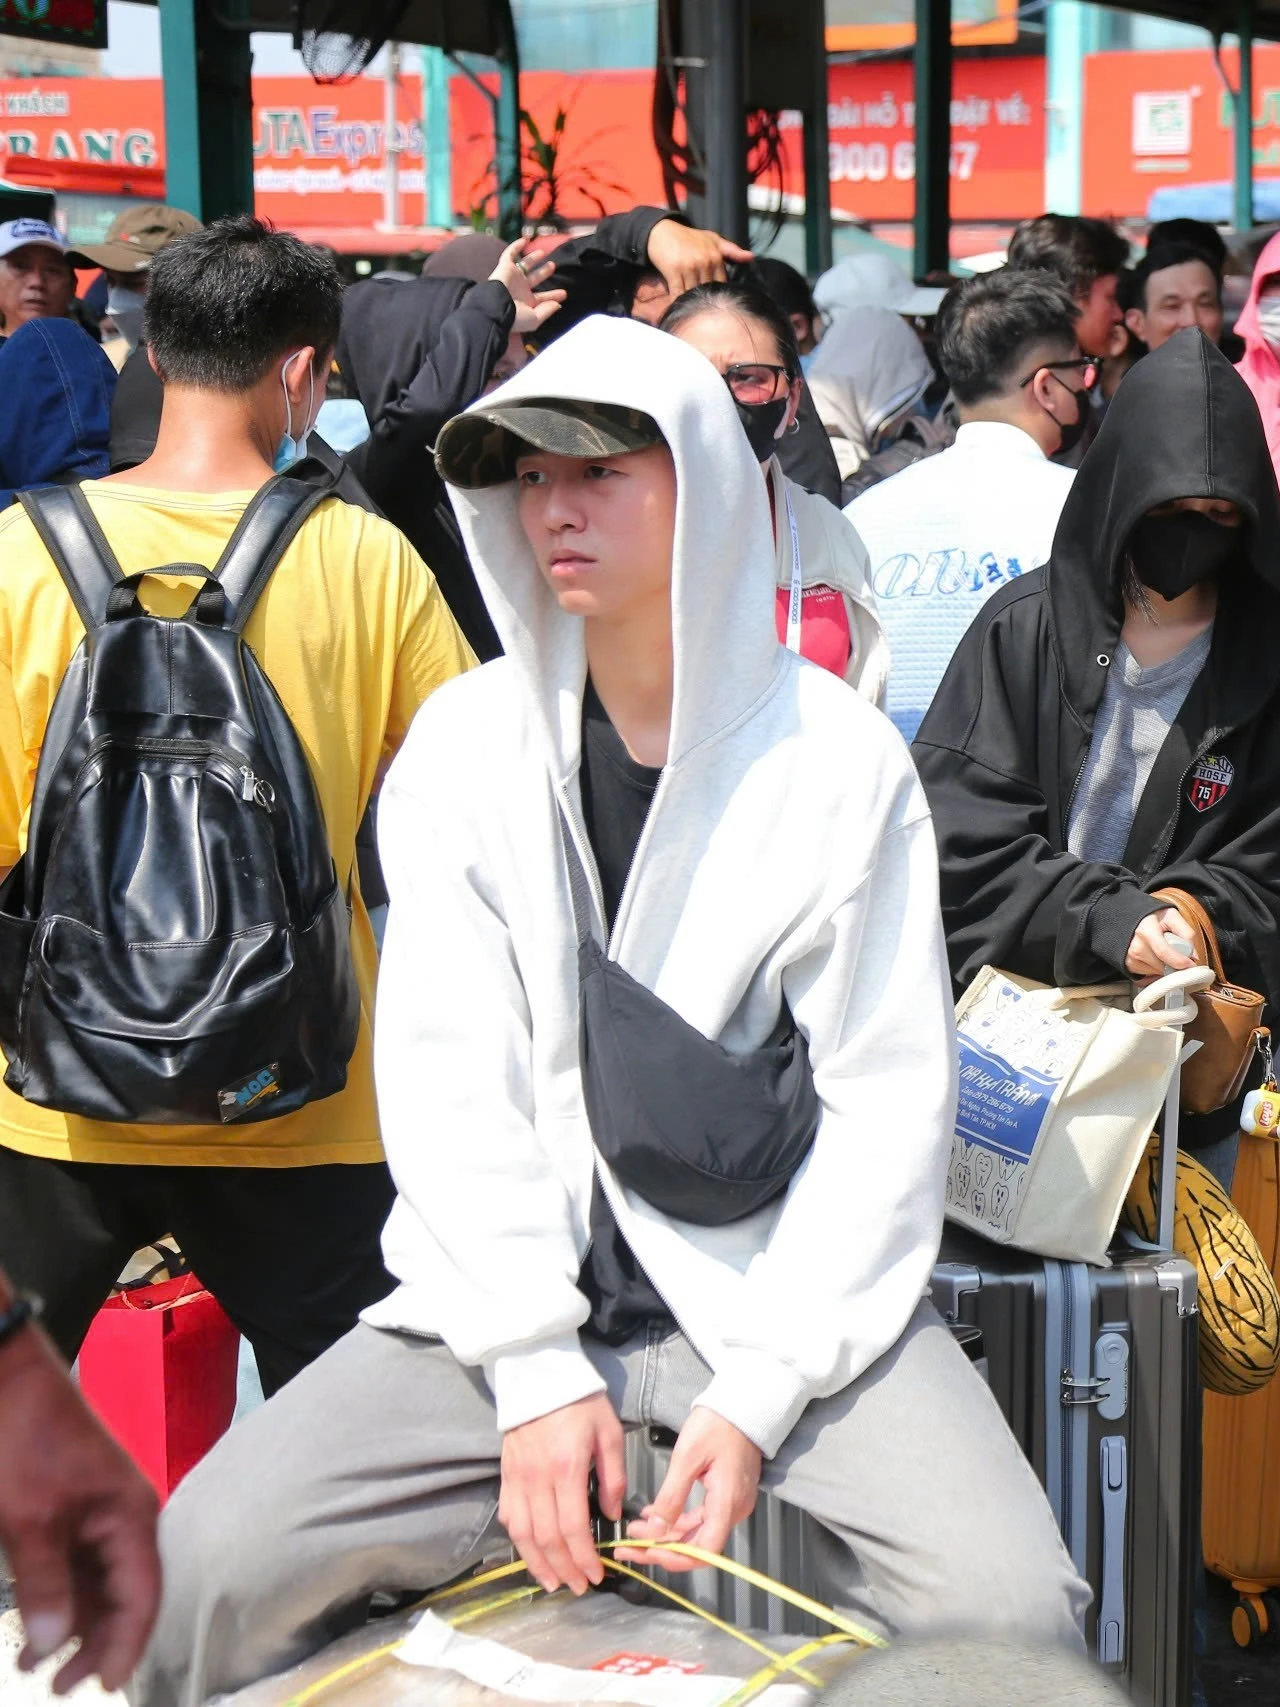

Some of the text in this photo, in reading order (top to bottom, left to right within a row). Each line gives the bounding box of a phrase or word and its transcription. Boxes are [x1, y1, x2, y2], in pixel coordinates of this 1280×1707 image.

[4, 128, 157, 168] RANG
[828, 142, 889, 182] 900
[1199, 768, 1228, 783] HOSE
[1198, 785, 1212, 800] 75
